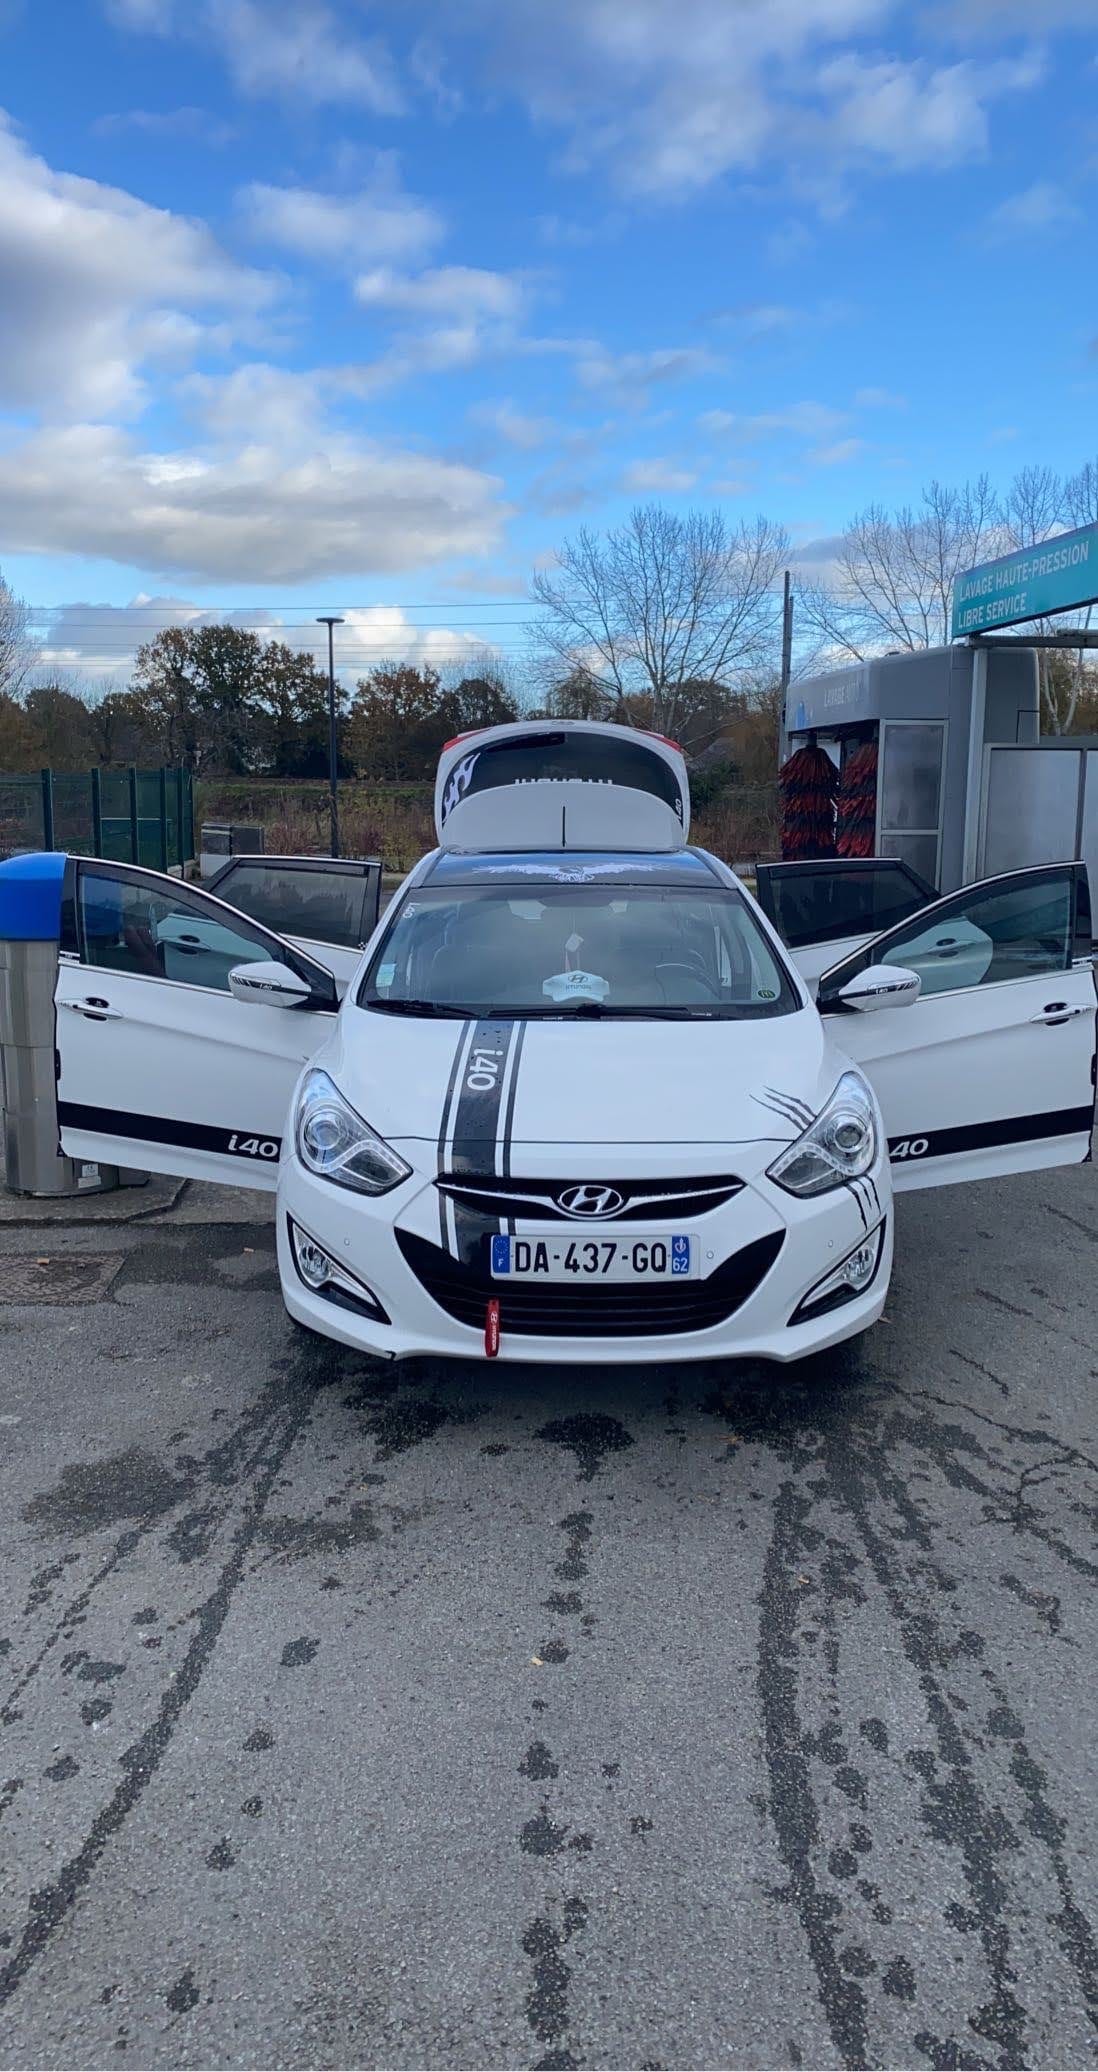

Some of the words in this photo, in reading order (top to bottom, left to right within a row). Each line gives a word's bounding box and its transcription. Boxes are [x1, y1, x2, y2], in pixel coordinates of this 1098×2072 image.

[959, 575, 993, 602] LAVAGE
[995, 541, 1089, 591] HAUTE-PRESSION
[958, 605, 984, 628] LIBRE
[986, 592, 1028, 621] SERVICE
[466, 1048, 504, 1091] i40
[227, 1134, 279, 1158] i40
[888, 1138, 929, 1158] 40
[498, 1258, 504, 1267] F
[514, 1242, 667, 1274] DA-437-GQ
[673, 1256, 688, 1272] 62
